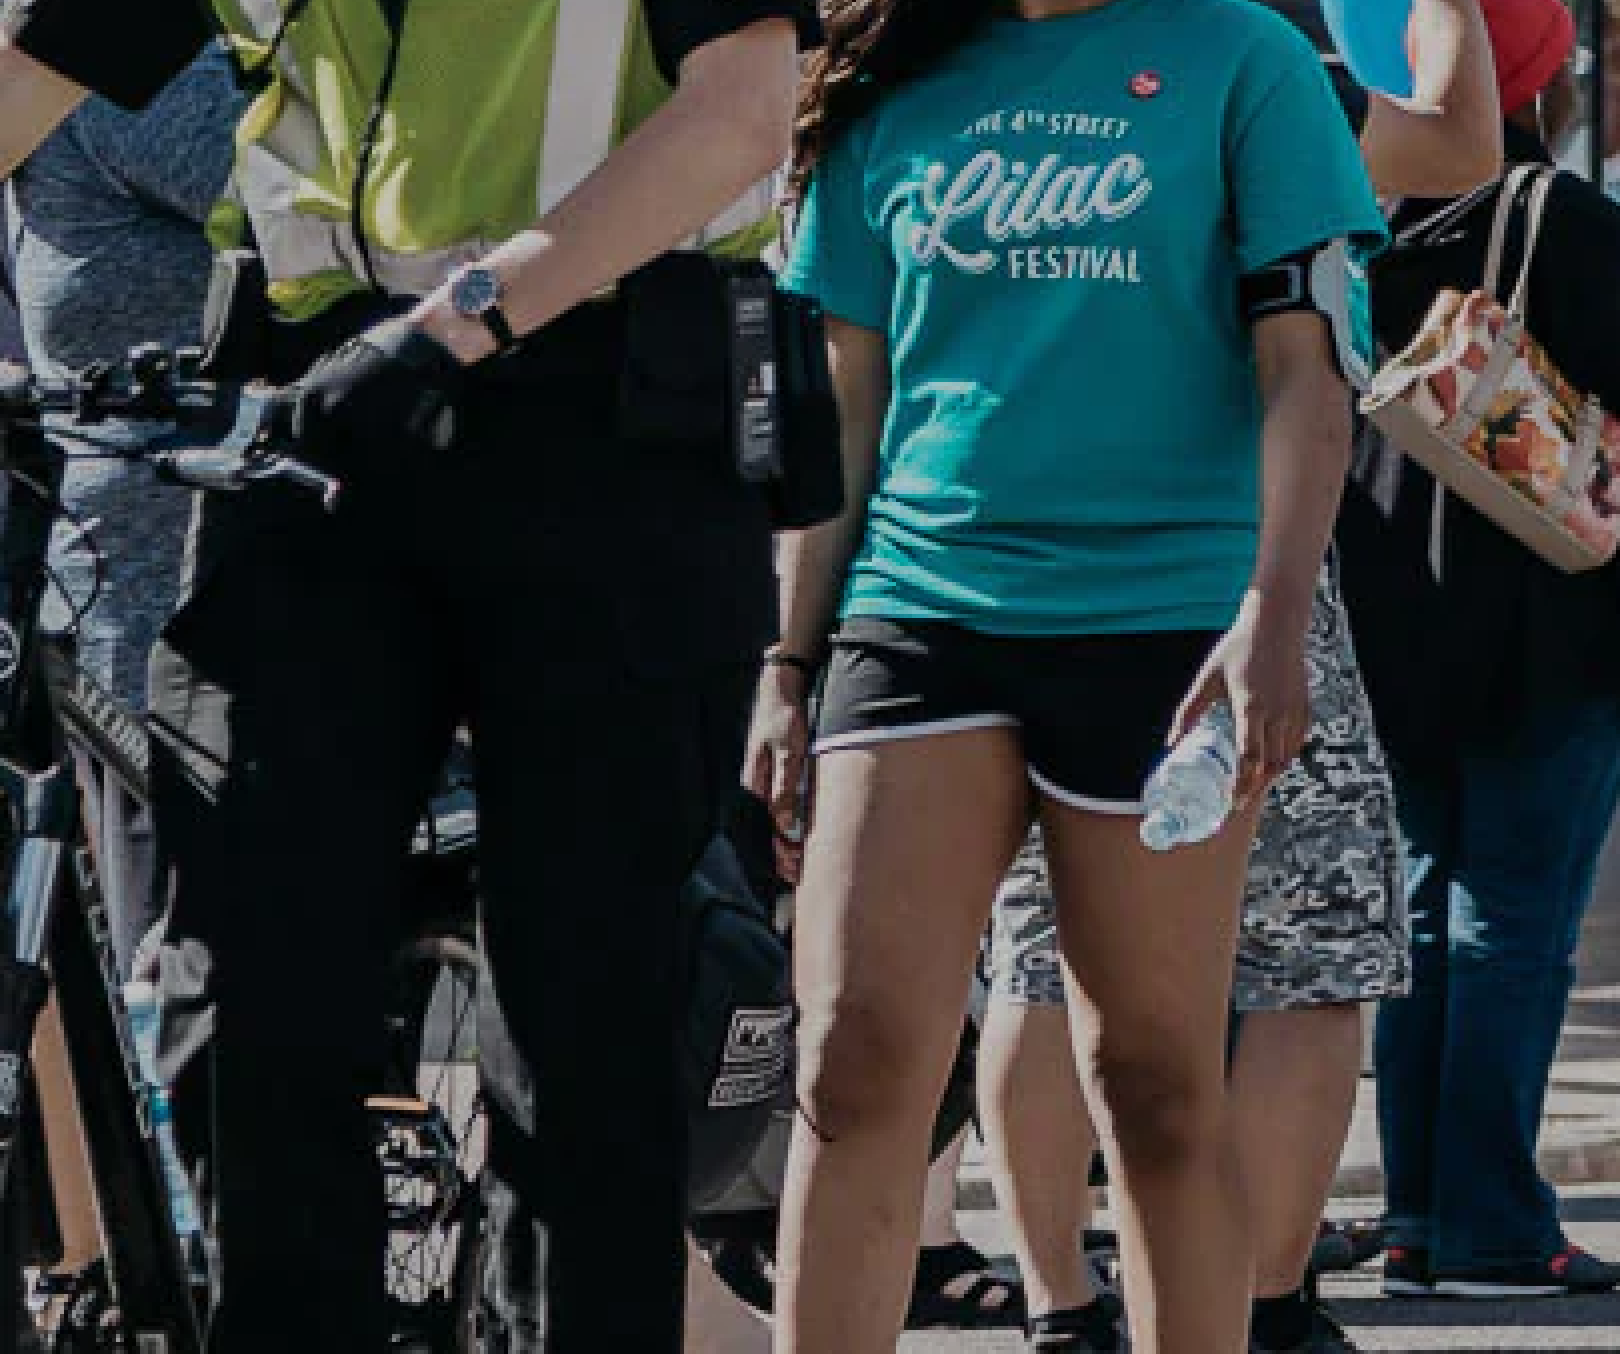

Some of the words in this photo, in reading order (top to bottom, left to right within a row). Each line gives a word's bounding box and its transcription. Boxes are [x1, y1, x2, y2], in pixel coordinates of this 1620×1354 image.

[1048, 113, 1133, 139] STREET
[911, 150, 1153, 274] Lilac
[1007, 246, 1141, 283] FESTIVAL
